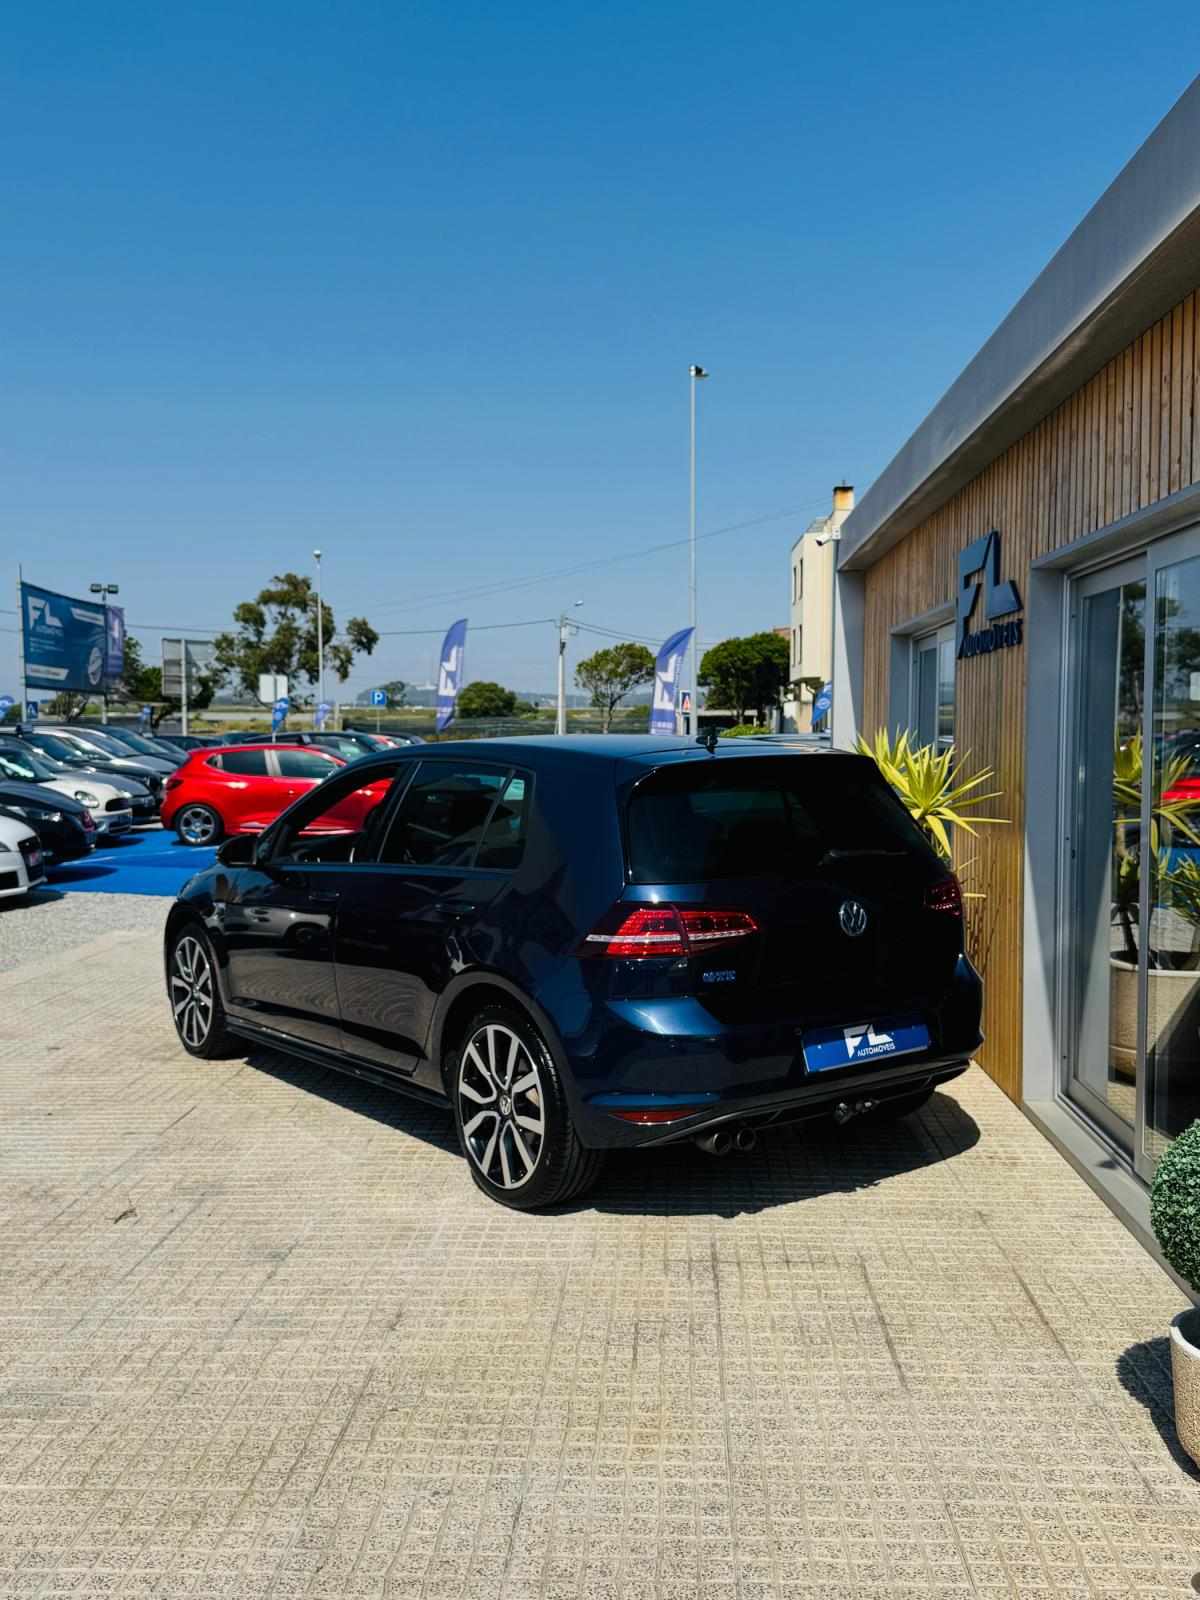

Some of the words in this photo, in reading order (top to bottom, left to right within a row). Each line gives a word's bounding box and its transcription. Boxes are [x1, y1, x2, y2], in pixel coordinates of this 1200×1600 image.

[28, 595, 63, 631] FL
[373, 691, 384, 705] P
[842, 1023, 895, 1059] FL
